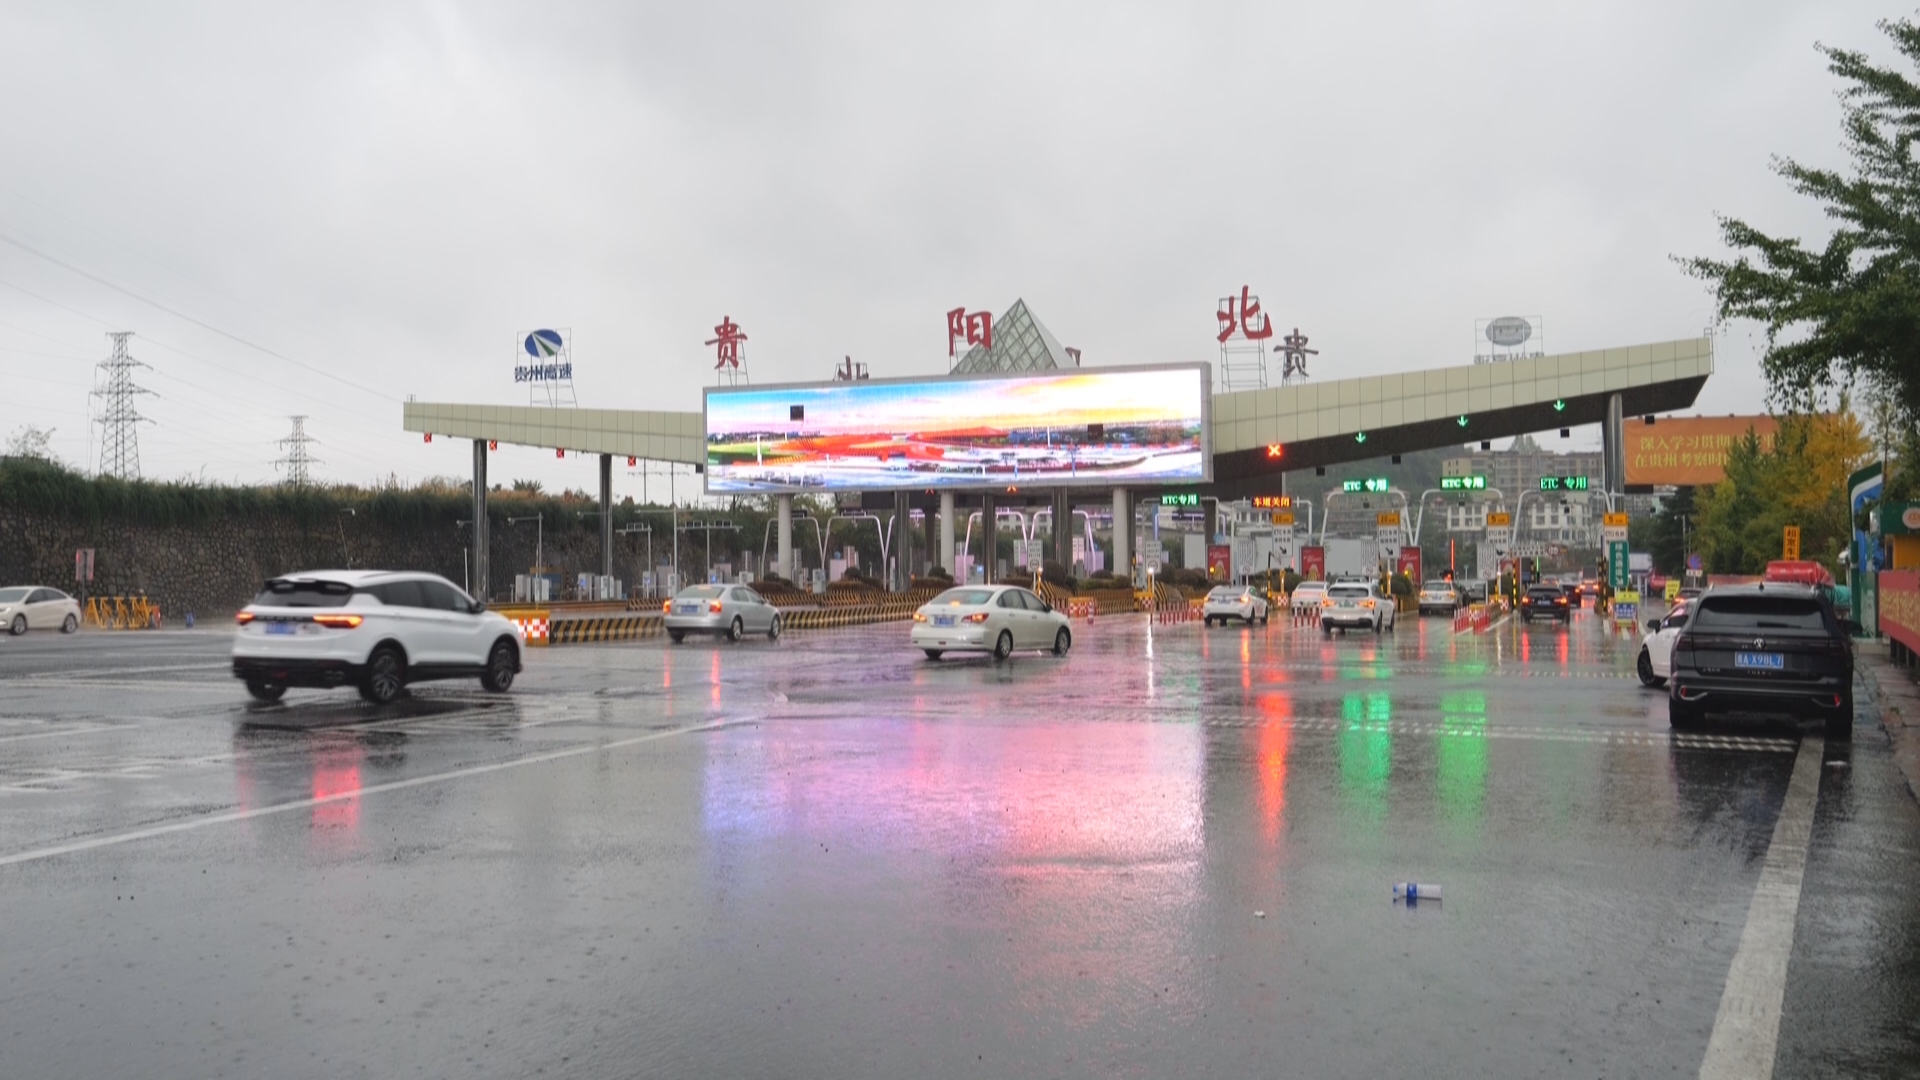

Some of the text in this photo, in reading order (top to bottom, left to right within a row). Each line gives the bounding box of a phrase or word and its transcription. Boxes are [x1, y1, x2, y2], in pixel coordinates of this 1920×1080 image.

[704, 285, 1273, 369] 贵 阳 北
[514, 363, 573, 383] 贵州高速
[1540, 476, 1586, 489] ETC 专用
[1253, 496, 1290, 507] 车道关闭
